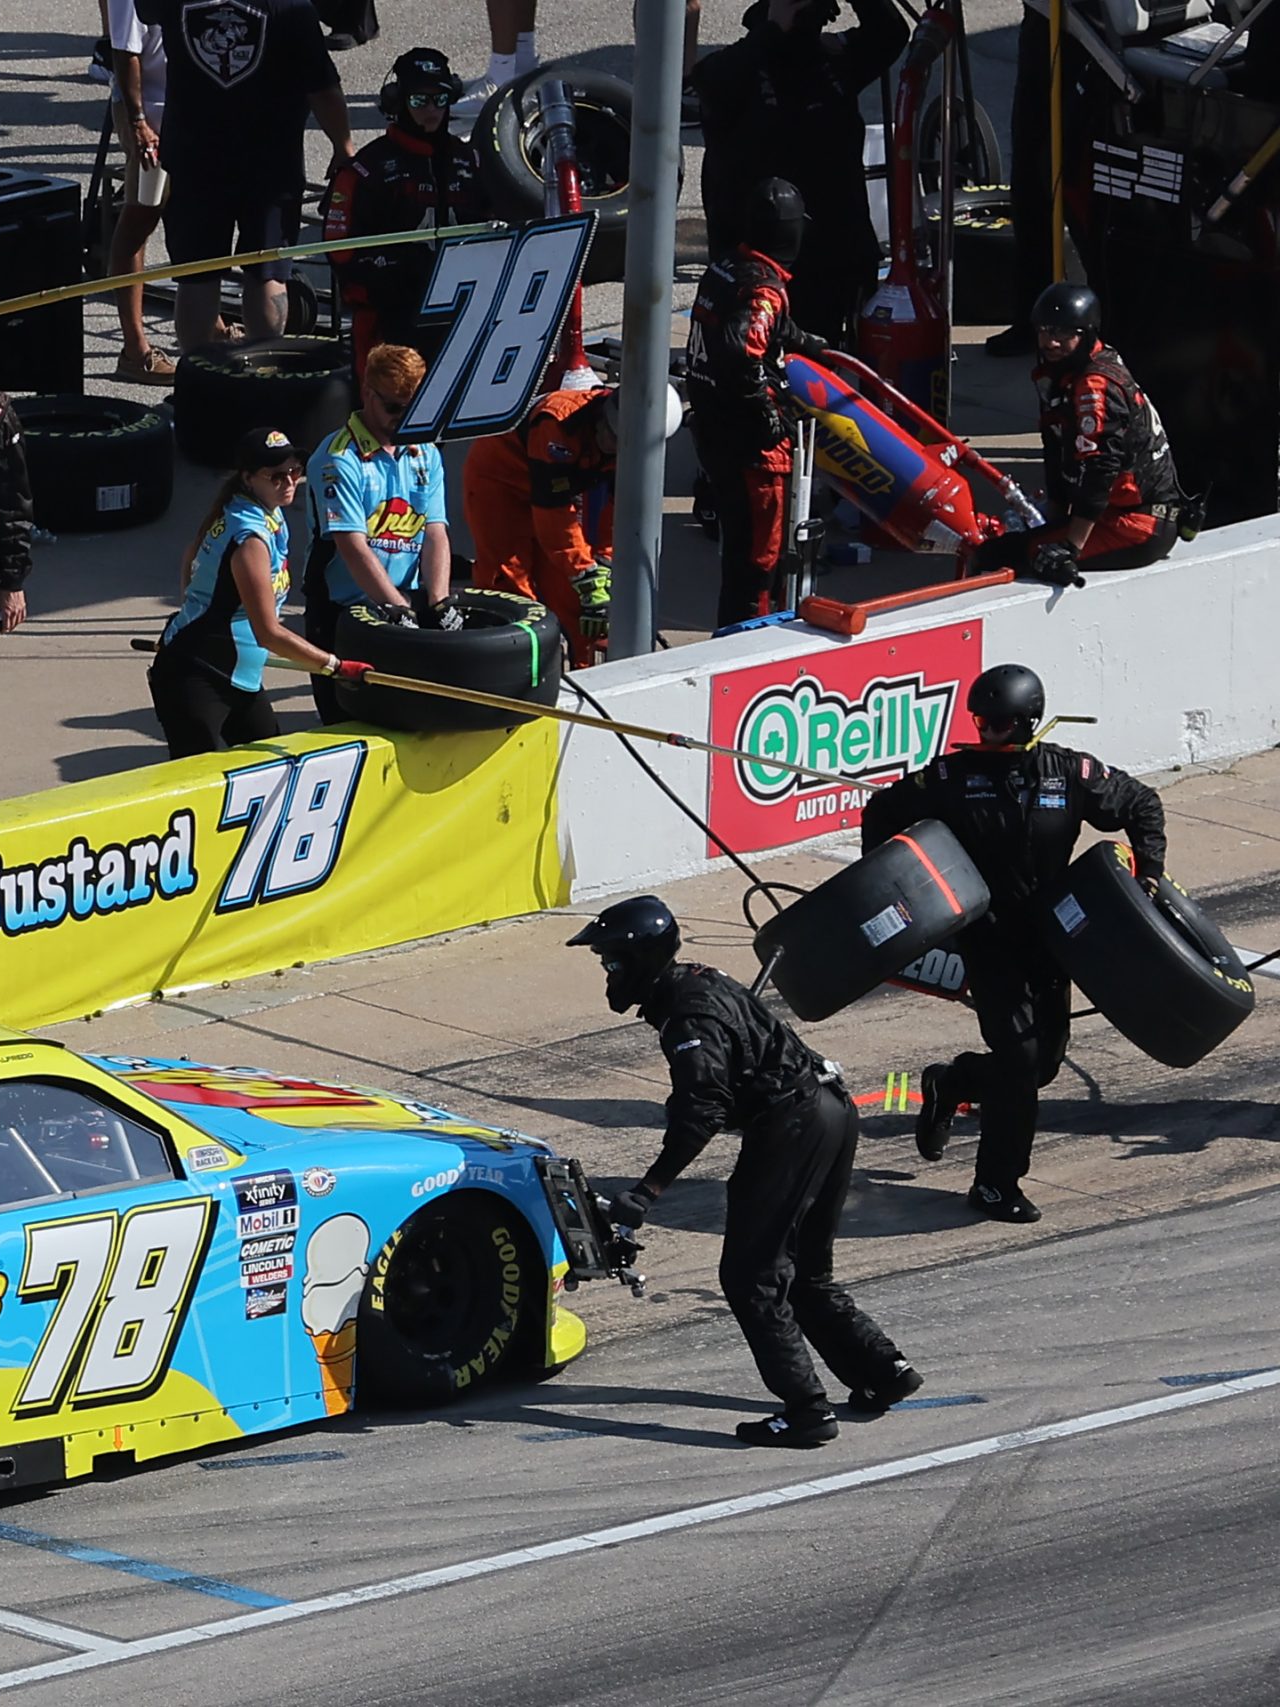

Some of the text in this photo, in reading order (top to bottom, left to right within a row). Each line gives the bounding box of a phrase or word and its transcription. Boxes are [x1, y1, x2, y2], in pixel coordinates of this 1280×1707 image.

[399, 221, 589, 430] 78
[747, 691, 949, 787] O'Reilly
[795, 793, 837, 822] AUTO
[219, 742, 365, 909] 78
[245, 1182, 286, 1205] xfinity
[240, 1211, 279, 1233] Mobil
[241, 1235, 295, 1258] COMETIC
[243, 1258, 284, 1275] LINCOLN
[251, 1269, 288, 1284] WELDERS
[371, 1229, 403, 1312] EAGLE
[13, 1195, 218, 1418] 78
